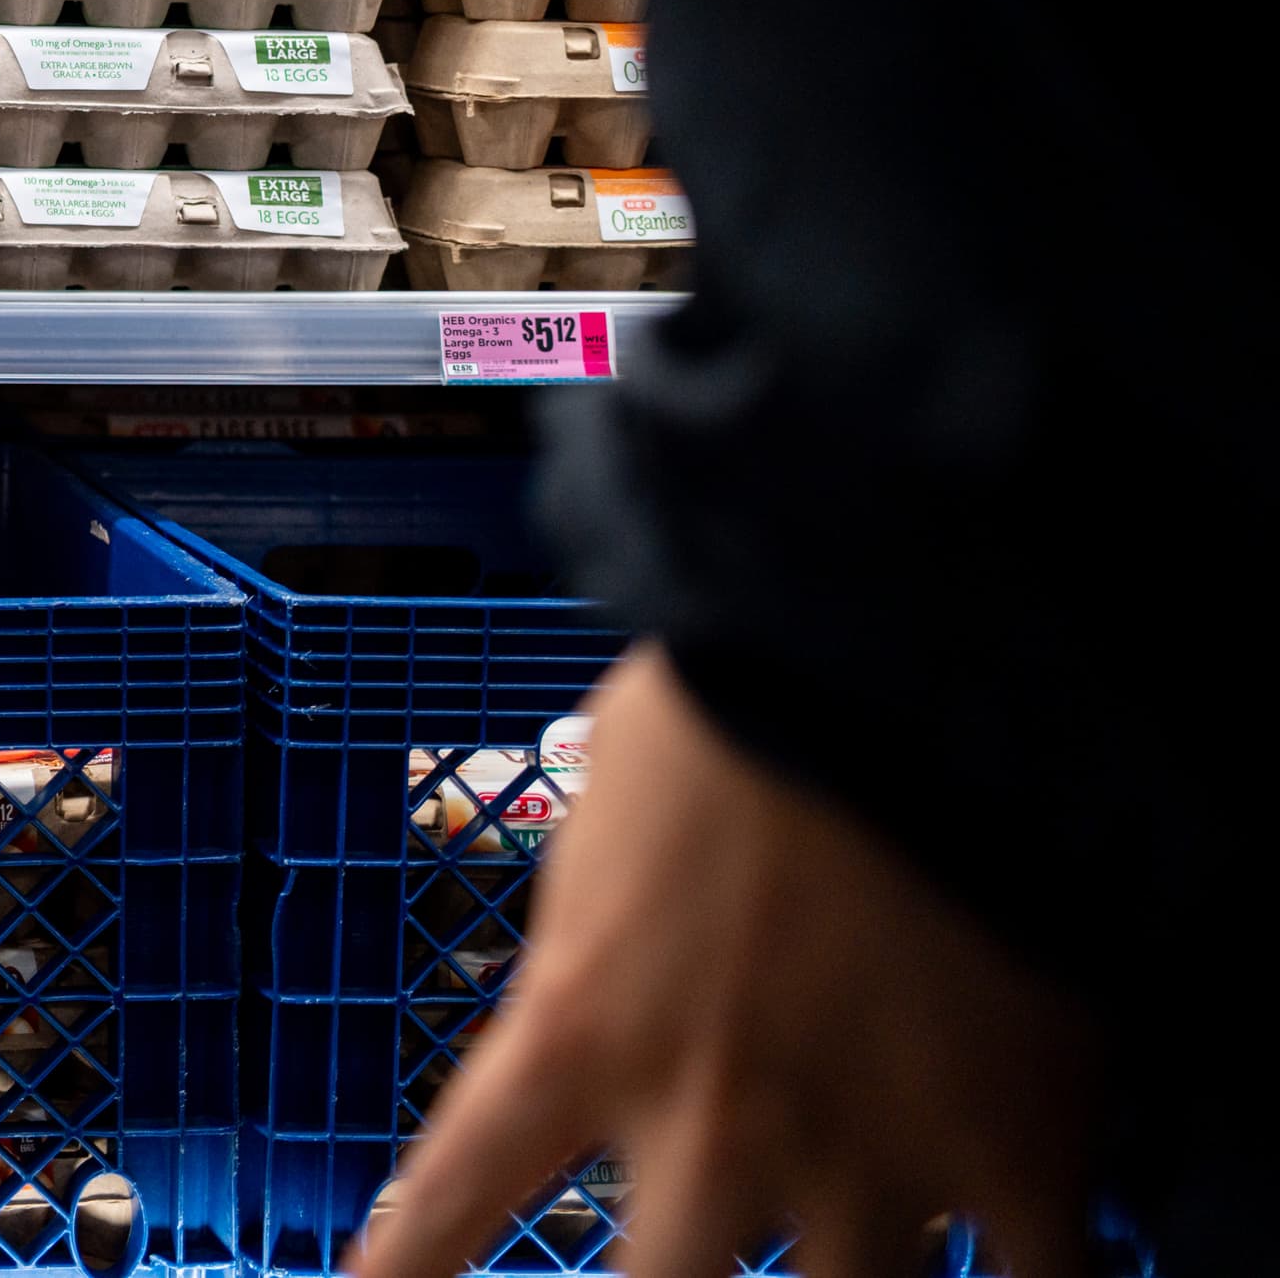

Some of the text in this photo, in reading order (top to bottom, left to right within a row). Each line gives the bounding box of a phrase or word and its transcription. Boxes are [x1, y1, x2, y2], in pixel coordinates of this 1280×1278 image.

[258, 179, 310, 192] EXTRA
[259, 190, 310, 203] LARGE
[258, 210, 320, 226] 18 EGGS
[611, 209, 687, 236] Organics
[443, 316, 516, 327] HEB Organics
[443, 327, 500, 337] Omega 3
[444, 338, 513, 349] Large Brown
[584, 335, 607, 343] WIC
[445, 350, 472, 360] Eggs
